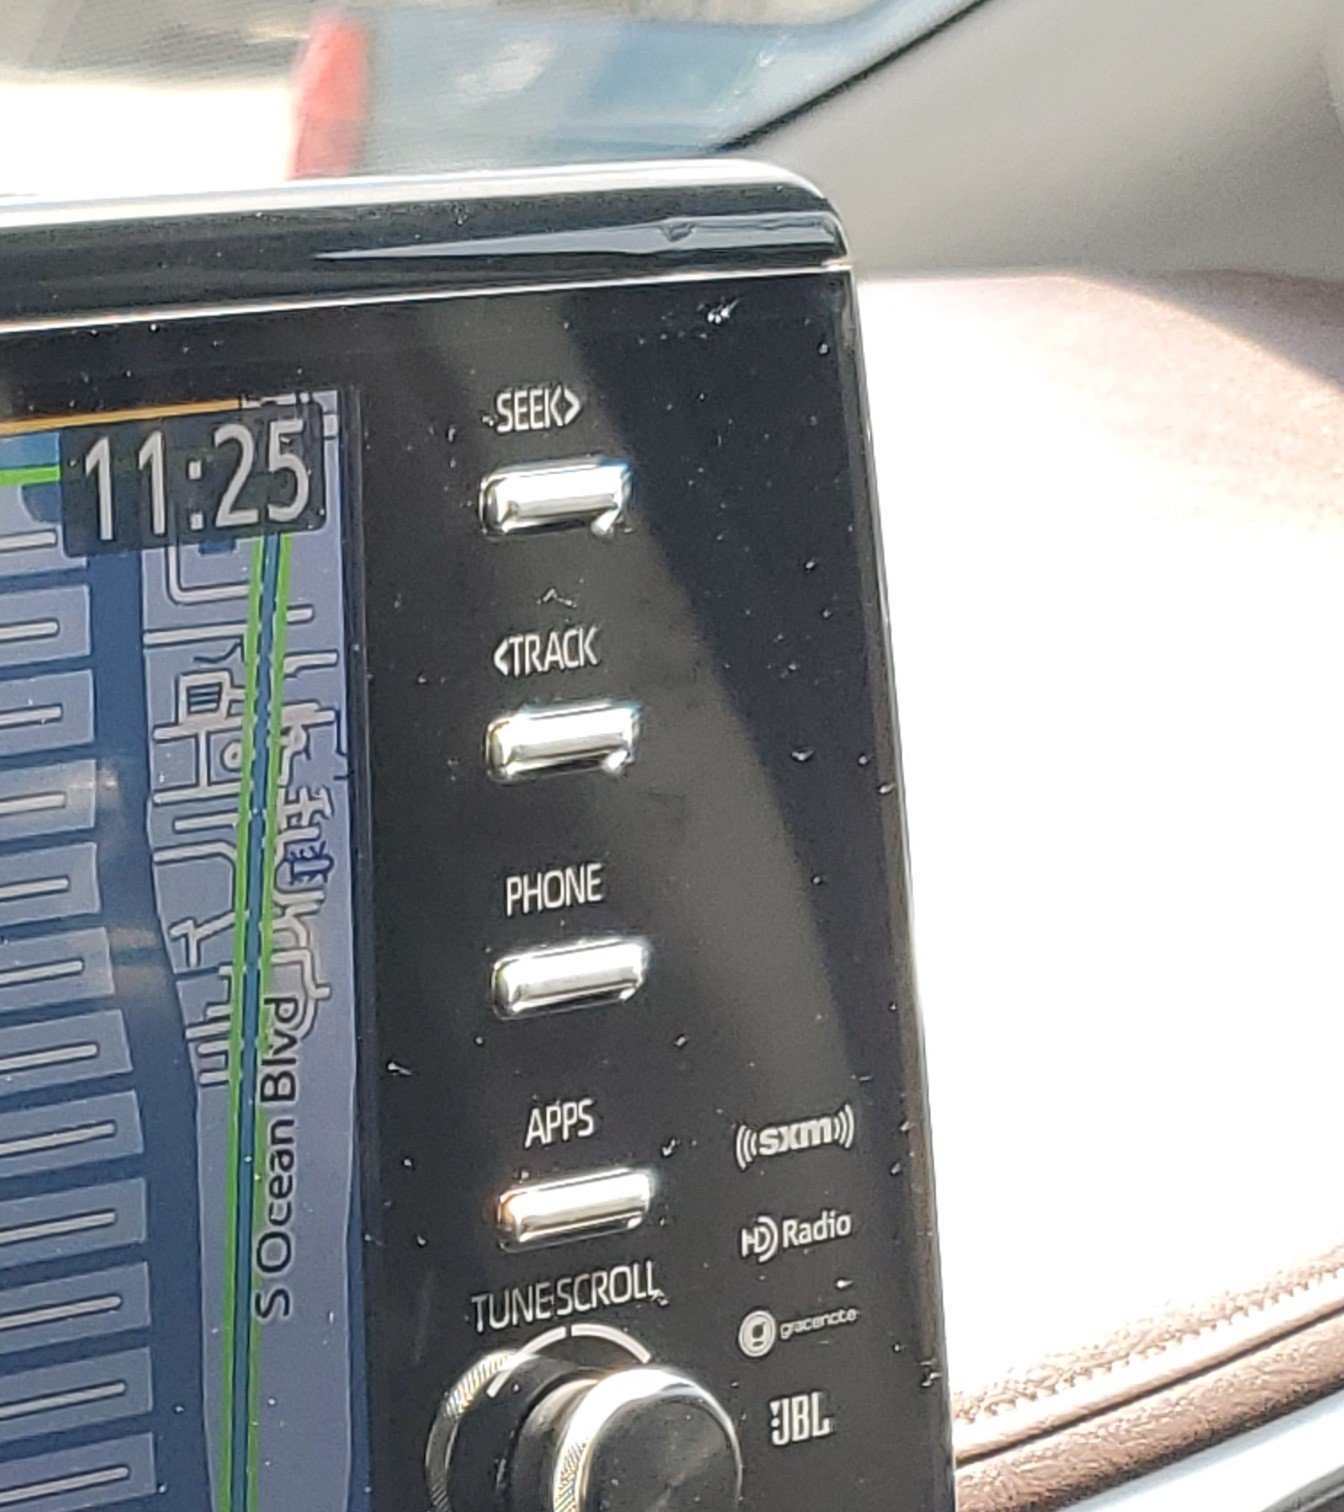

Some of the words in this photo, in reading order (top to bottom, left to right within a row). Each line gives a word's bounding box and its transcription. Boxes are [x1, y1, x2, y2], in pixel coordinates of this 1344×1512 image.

[496, 390, 561, 434] SEEK
[84, 418, 312, 542] 11:25
[503, 627, 599, 673] TRACK
[506, 863, 603, 916] PHONE
[260, 996, 301, 1104] Blvd
[524, 1098, 595, 1150] APPS
[758, 1115, 834, 1157] sxm
[256, 1118, 297, 1275] Ocean
[782, 1210, 853, 1248] Radio
[255, 1290, 291, 1320] S
[472, 1282, 552, 1334] TUNE
[555, 1260, 658, 1318] SCROLL
[769, 1392, 832, 1446] JBL
